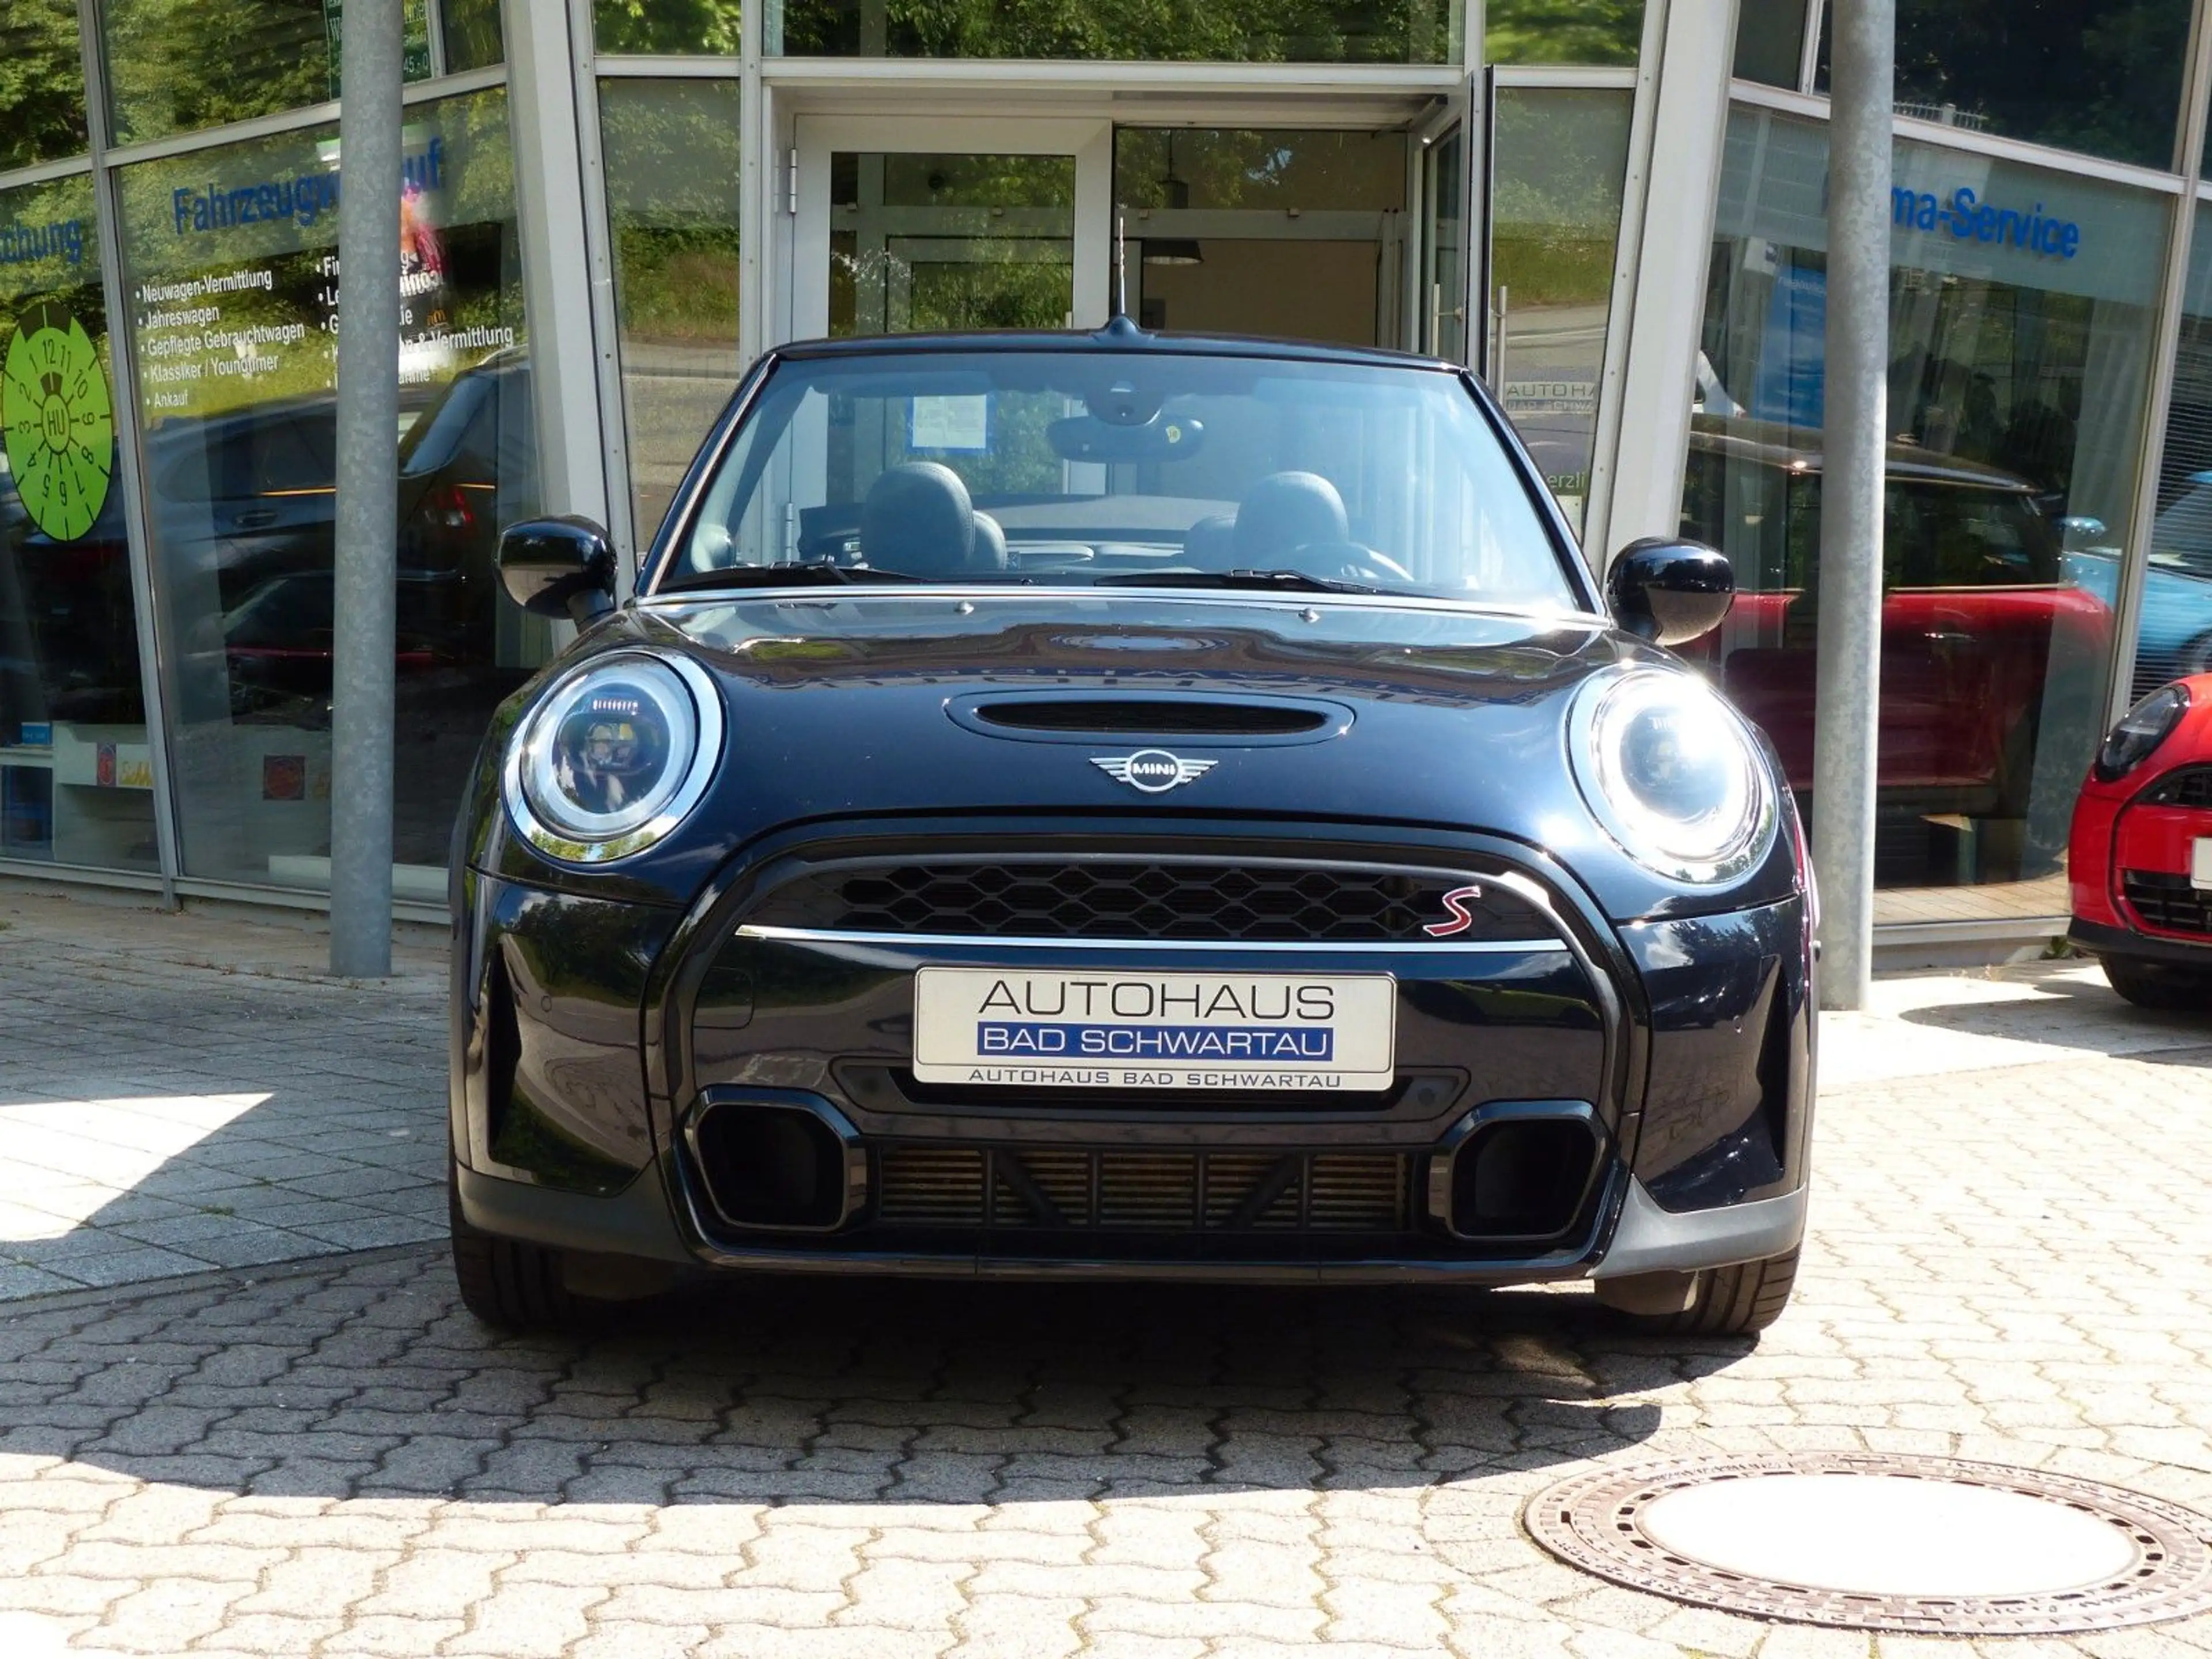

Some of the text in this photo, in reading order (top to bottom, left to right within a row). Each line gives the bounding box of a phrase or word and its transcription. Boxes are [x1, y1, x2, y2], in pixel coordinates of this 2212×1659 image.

[173, 136, 442, 235] Fahrzeugvuf
[0, 219, 81, 264] chung
[143, 270, 272, 302] Neuwagen-Vermittlung
[146, 306, 219, 329] Jahreswagen
[147, 335, 201, 358] Gepflegte
[204, 323, 305, 349] Gebrauchtwagen
[430, 325, 514, 352] Vermittlung
[43, 339, 56, 365] 12
[150, 362, 201, 383] Klassiker
[210, 353, 279, 378] Youngtimer
[19, 381, 31, 402] 2
[154, 389, 189, 408] Ankauf
[18, 420, 31, 434] 3
[47, 409, 65, 437] HU
[28, 452, 37, 468] 4
[81, 445, 95, 465] 8
[1546, 471, 1585, 488] erzli
[1132, 763, 1176, 775] MINI
[1422, 885, 1481, 937] S
[978, 980, 1335, 1020] AUTOHAUS
[983, 1028, 1328, 1056] BAD SCHWARTAU
[969, 1069, 1340, 1088] AUTOHAUS BAD SCHWARTAU
